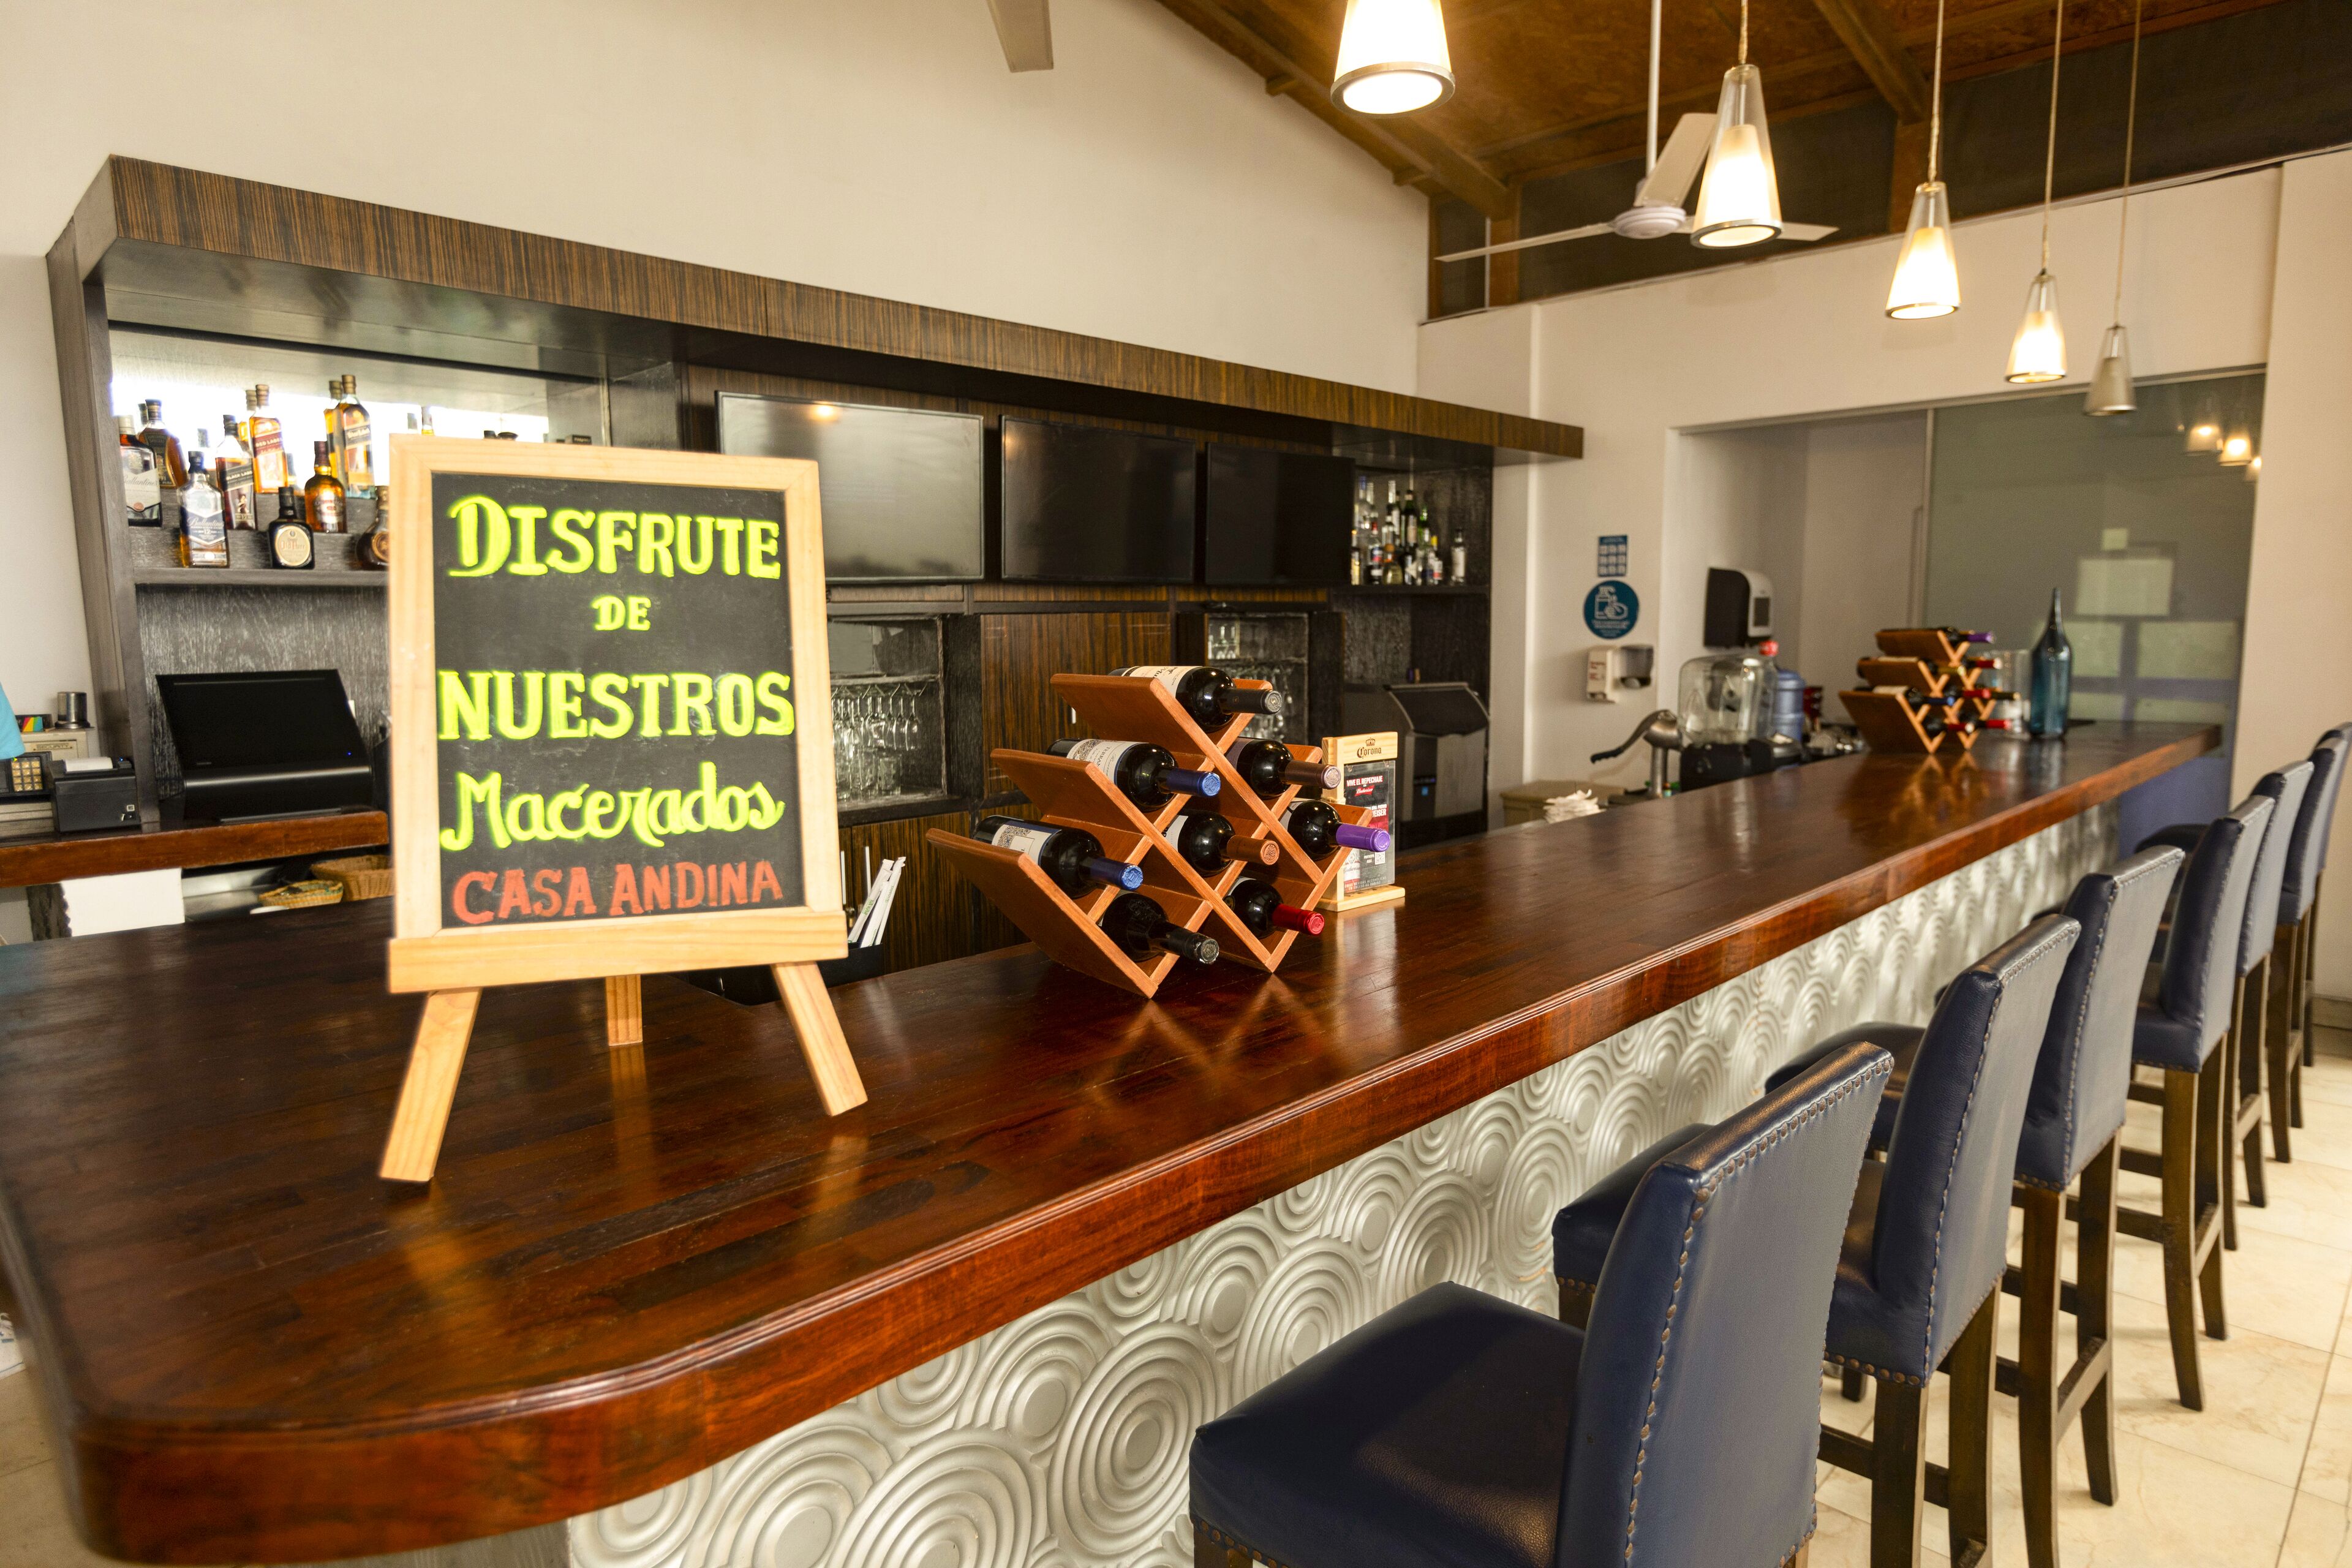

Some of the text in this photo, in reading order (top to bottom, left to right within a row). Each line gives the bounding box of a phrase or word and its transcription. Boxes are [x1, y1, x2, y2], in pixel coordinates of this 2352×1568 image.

[448, 495, 782, 579] DISFRUTE
[592, 596, 652, 631] DE
[437, 670, 795, 741] NUESTROS
[1357, 747, 1382, 759] Corona
[1361, 775, 1383, 785] REPECHAJE
[440, 761, 786, 851] Macerados
[453, 861, 783, 924] CASA ANDINA
